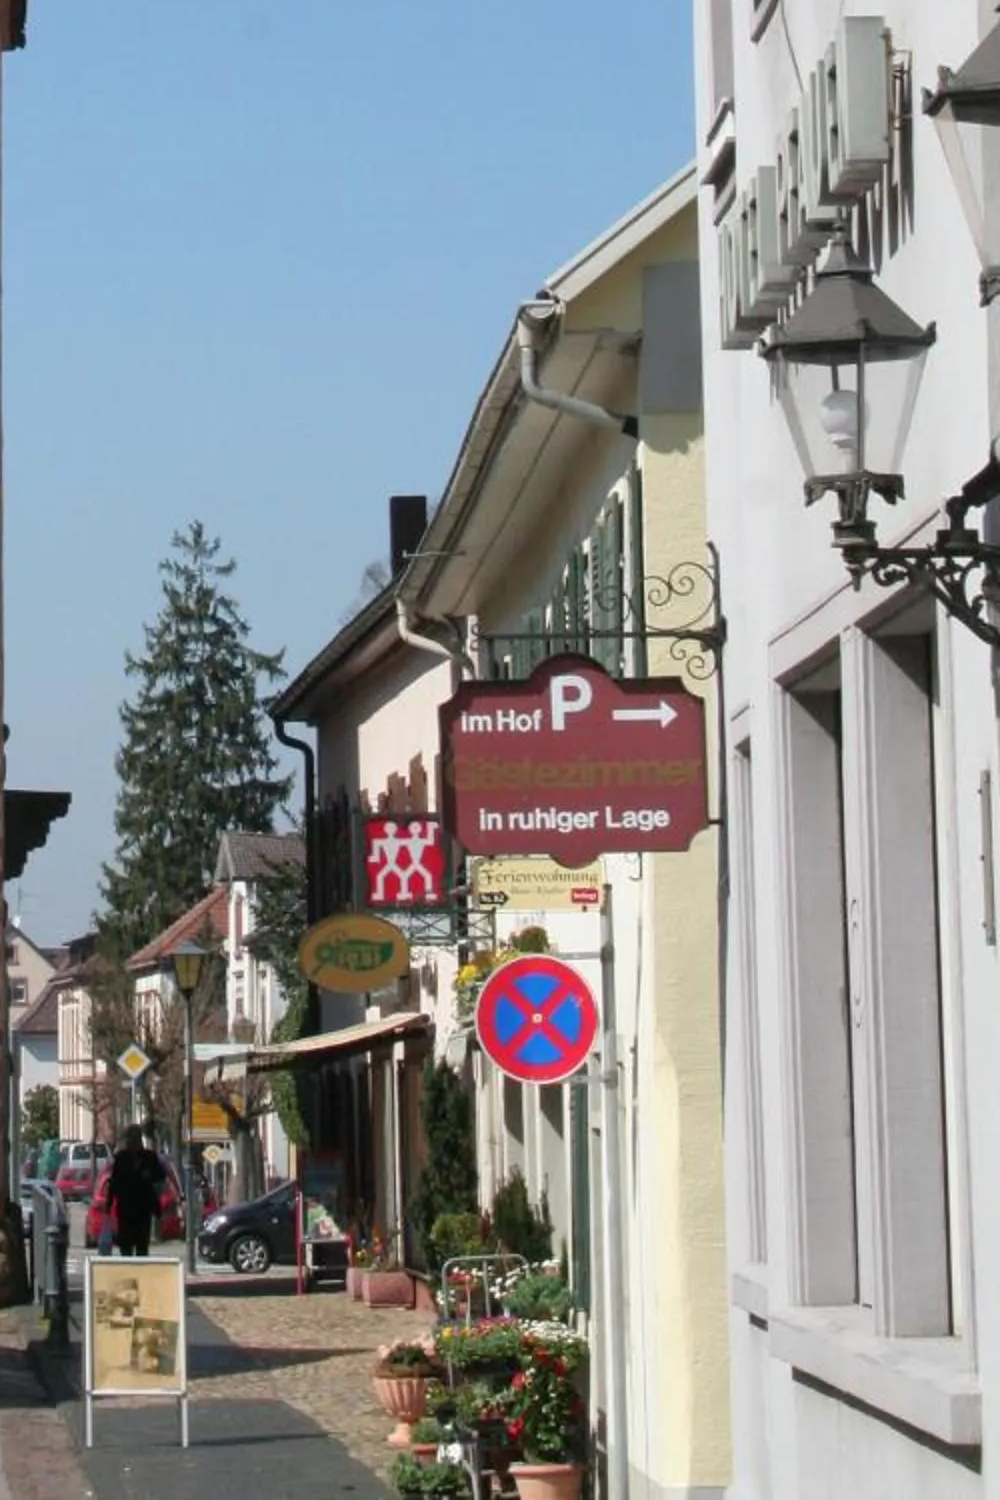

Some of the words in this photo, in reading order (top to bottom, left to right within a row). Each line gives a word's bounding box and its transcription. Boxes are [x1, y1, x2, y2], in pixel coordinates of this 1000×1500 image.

[461, 711, 493, 732] im
[496, 709, 542, 732] Hof
[551, 675, 592, 731] P
[479, 808, 502, 831] in
[508, 808, 599, 833] ruhiger
[605, 806, 670, 831] Lage
